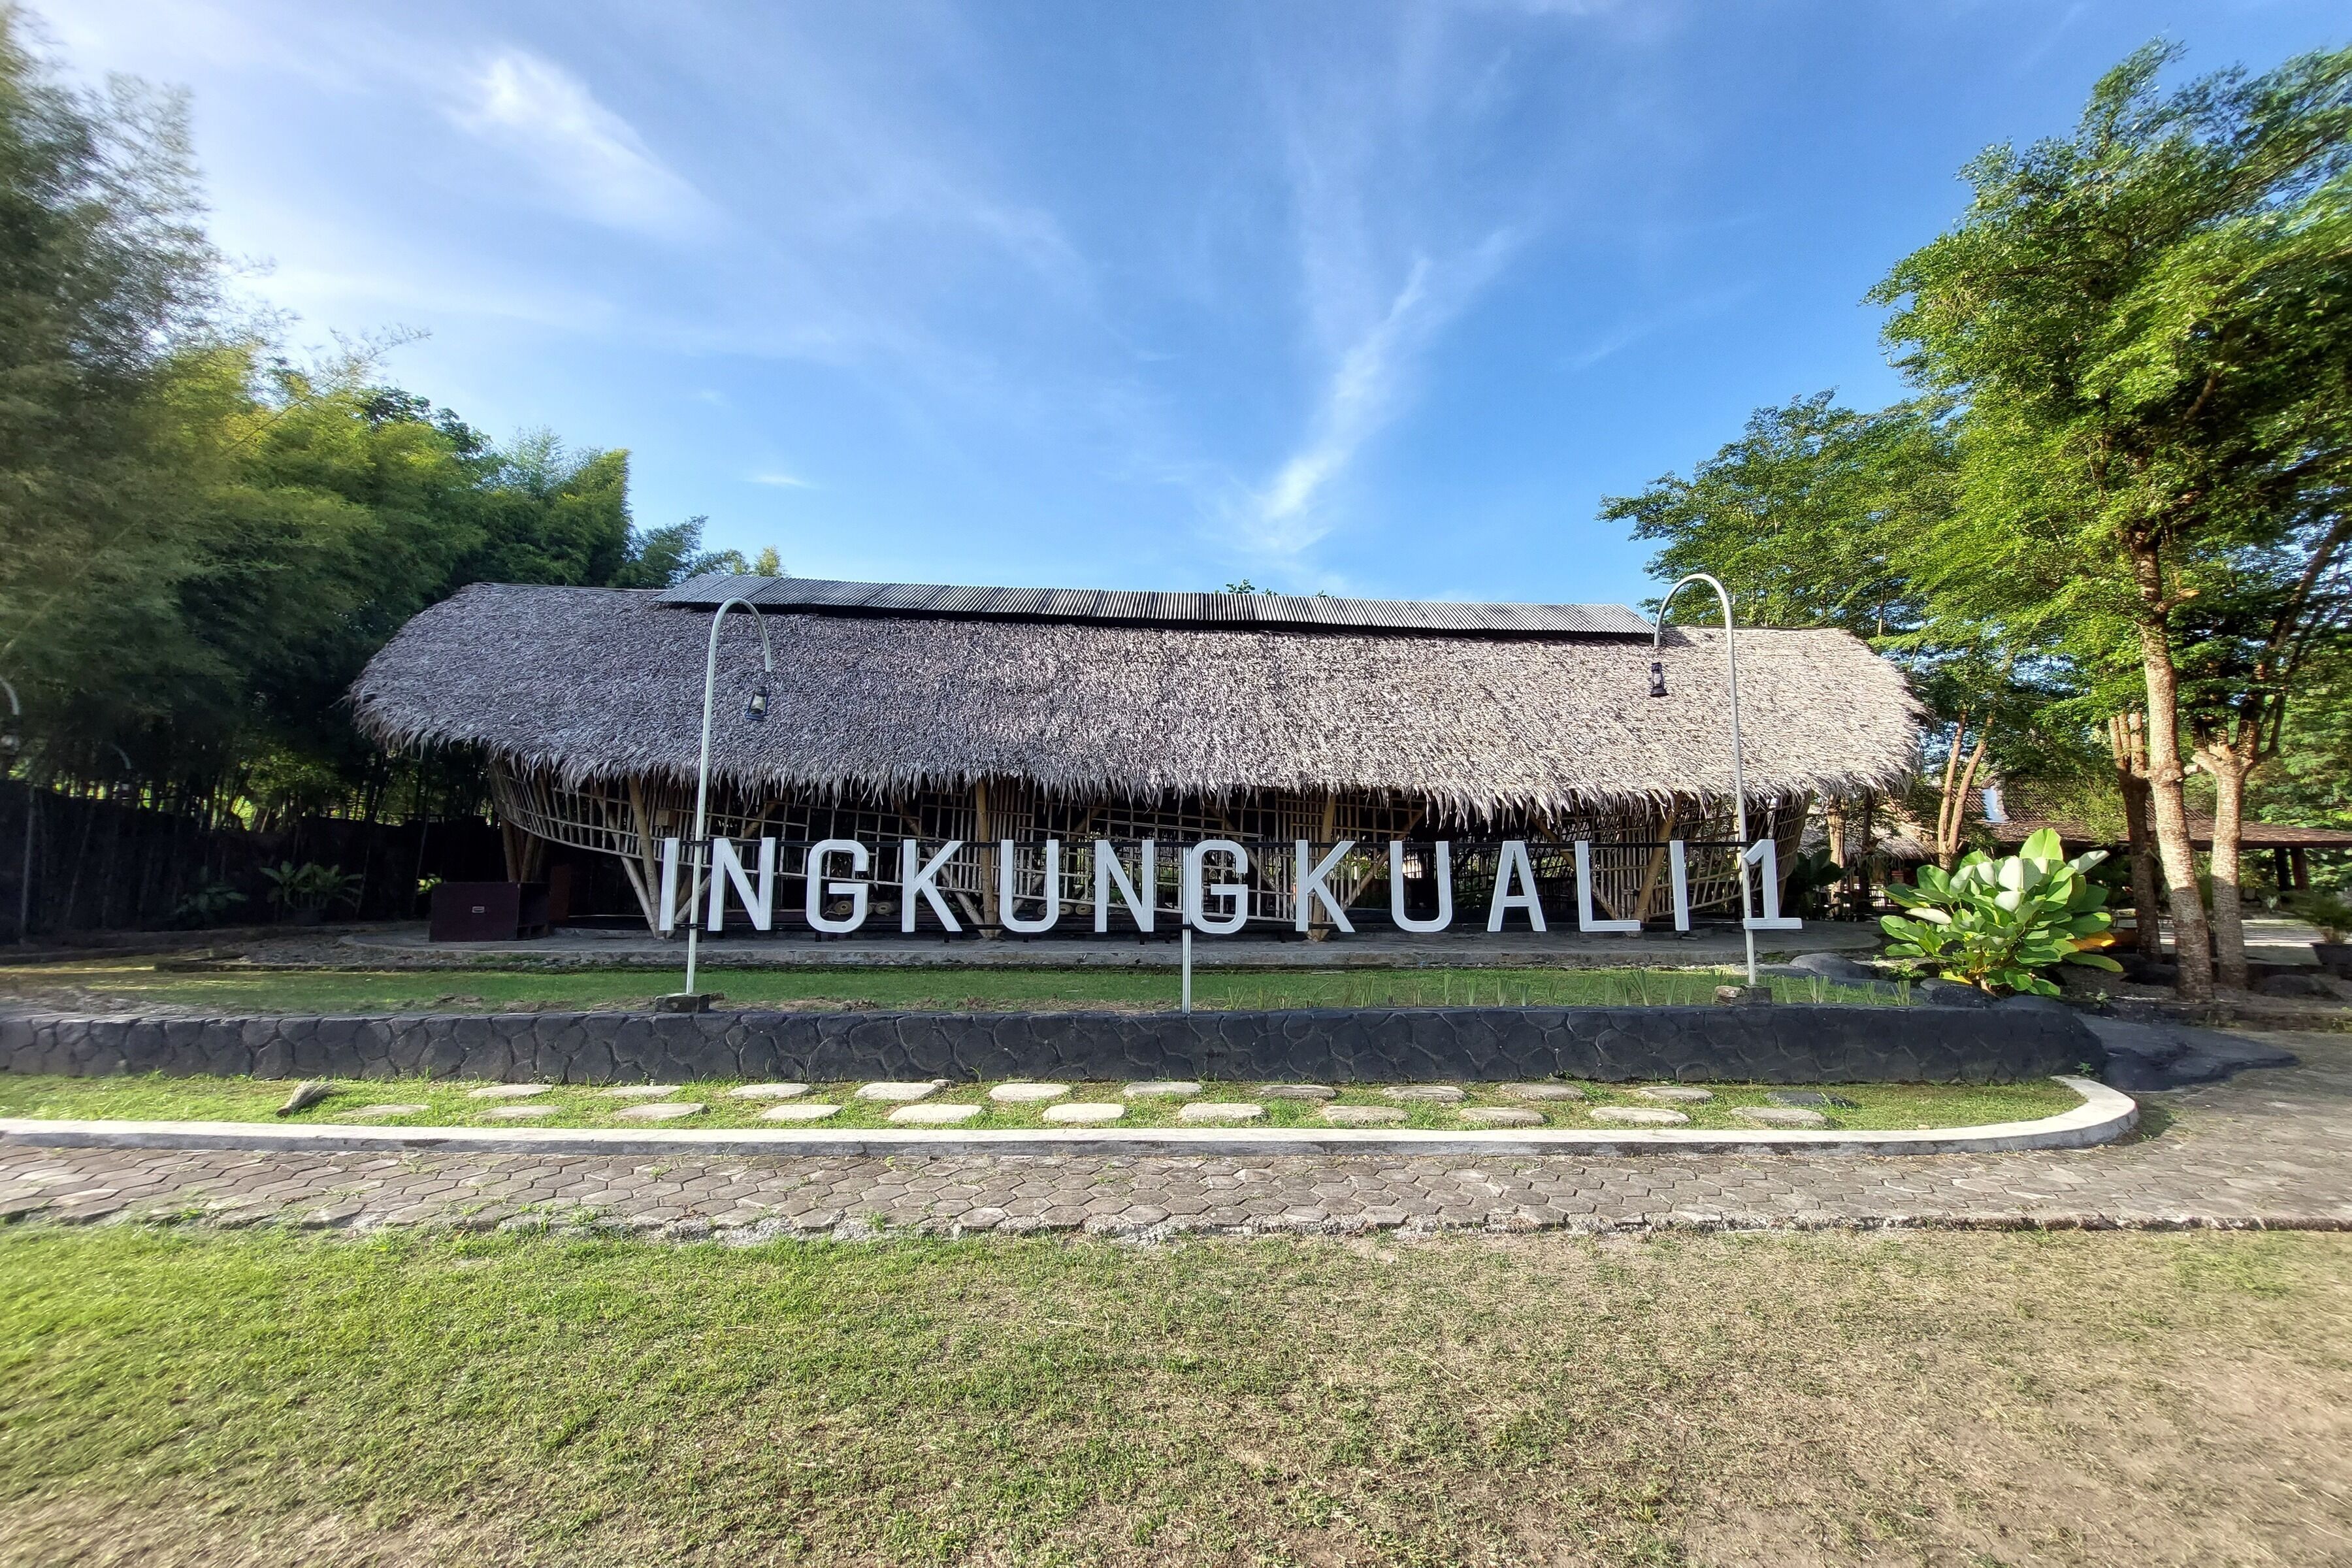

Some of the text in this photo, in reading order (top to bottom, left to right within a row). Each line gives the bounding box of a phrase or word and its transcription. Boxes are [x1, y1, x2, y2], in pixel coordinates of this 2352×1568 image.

[659, 837, 1803, 934] INGKUNG KUALI 1
